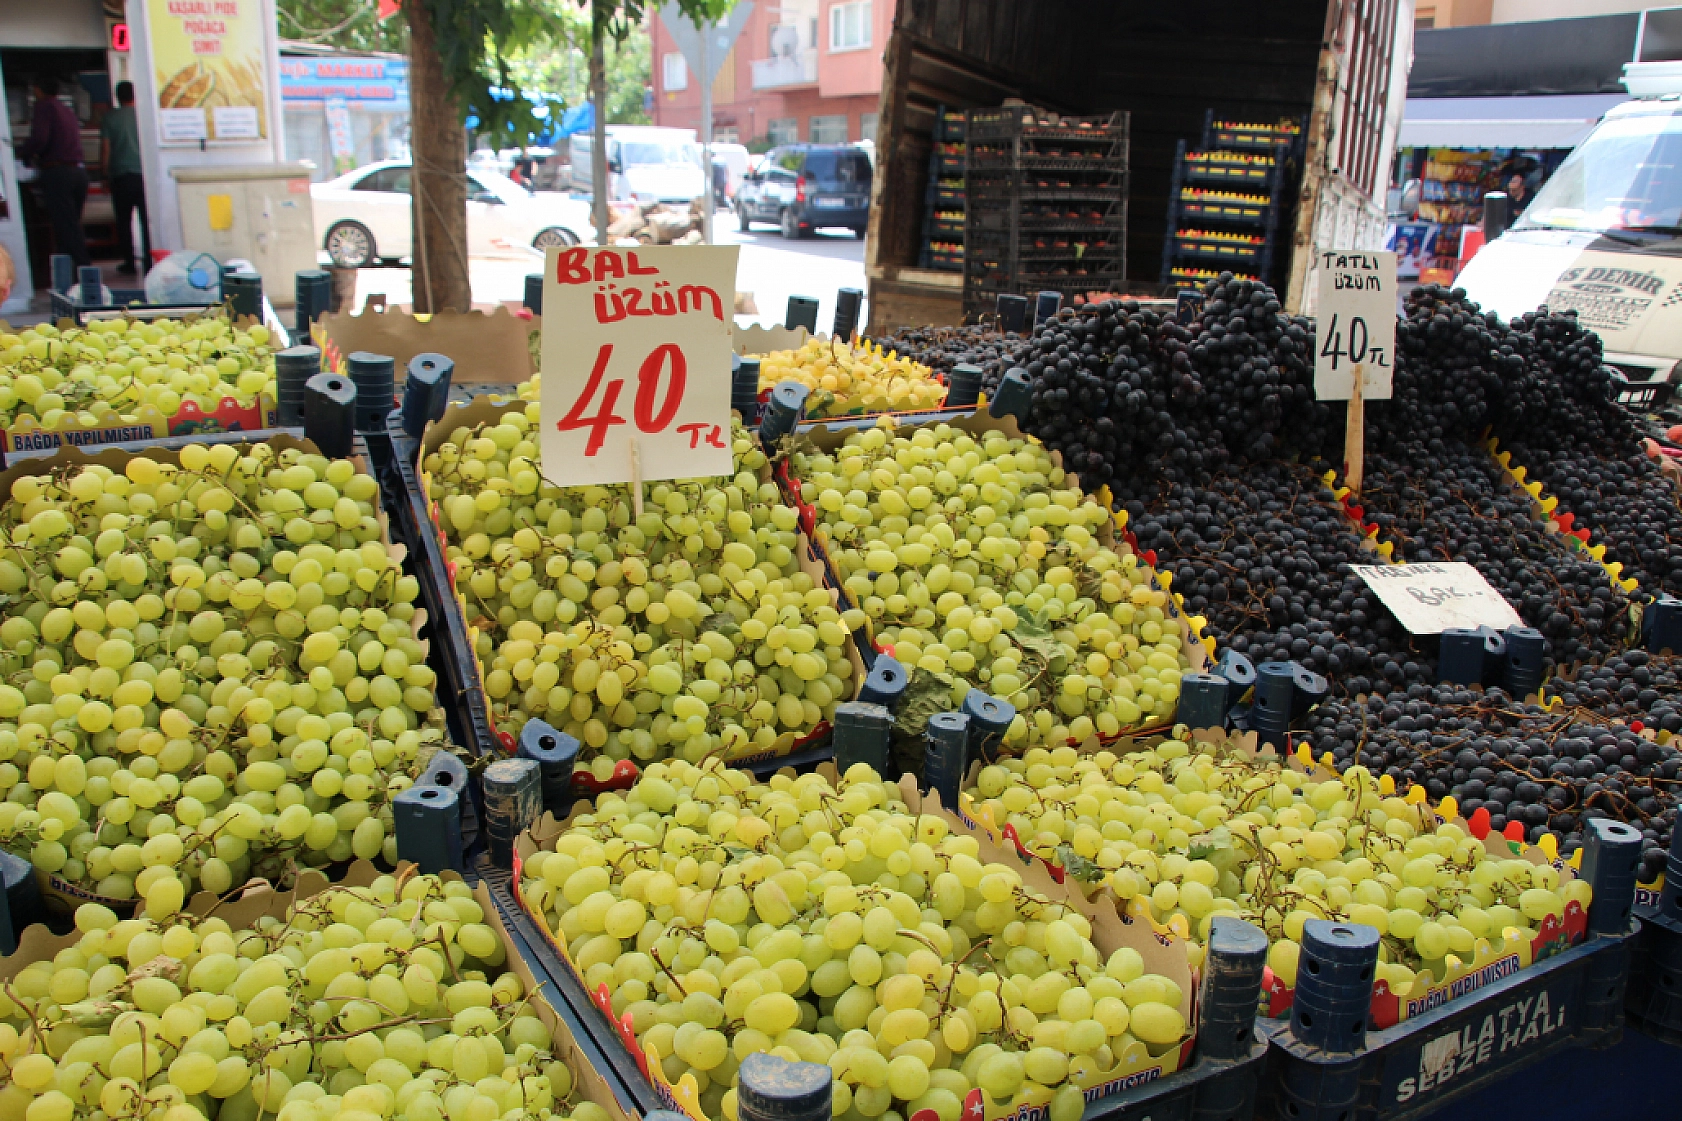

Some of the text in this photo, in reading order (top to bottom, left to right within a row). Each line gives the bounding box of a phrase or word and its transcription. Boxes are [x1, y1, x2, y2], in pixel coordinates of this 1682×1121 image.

[317, 63, 384, 78] MARKET
[557, 247, 660, 284] BAL
[1322, 251, 1379, 270] TATLI
[1335, 272, 1381, 291] ÜZÜM
[1321, 313, 1391, 371] 40 TL
[556, 343, 688, 457] 40
[1395, 1038, 1494, 1103] SEBZE
